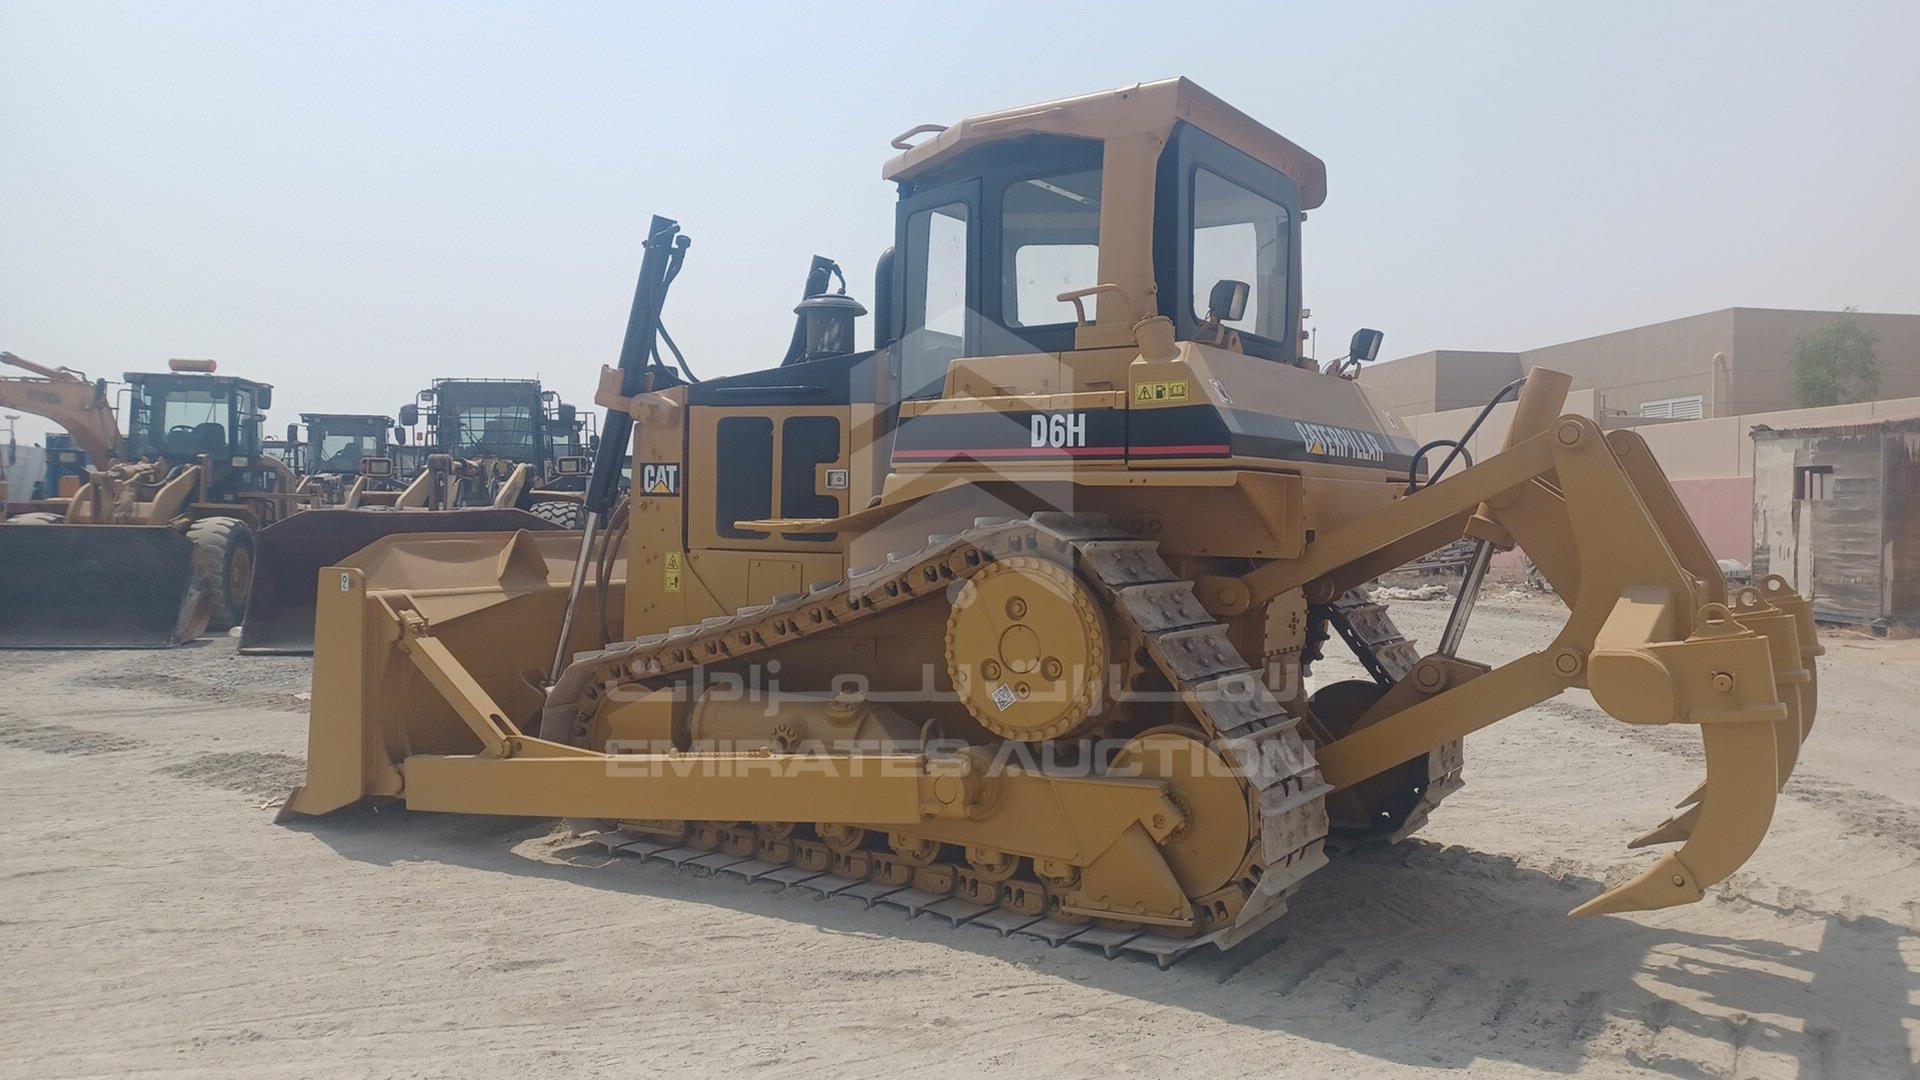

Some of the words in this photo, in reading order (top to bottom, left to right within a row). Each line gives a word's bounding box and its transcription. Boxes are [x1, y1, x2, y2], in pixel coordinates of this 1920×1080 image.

[1031, 413, 1086, 448] D6H
[1294, 421, 1384, 462] CATERPILLAR
[643, 464, 677, 494] CAT
